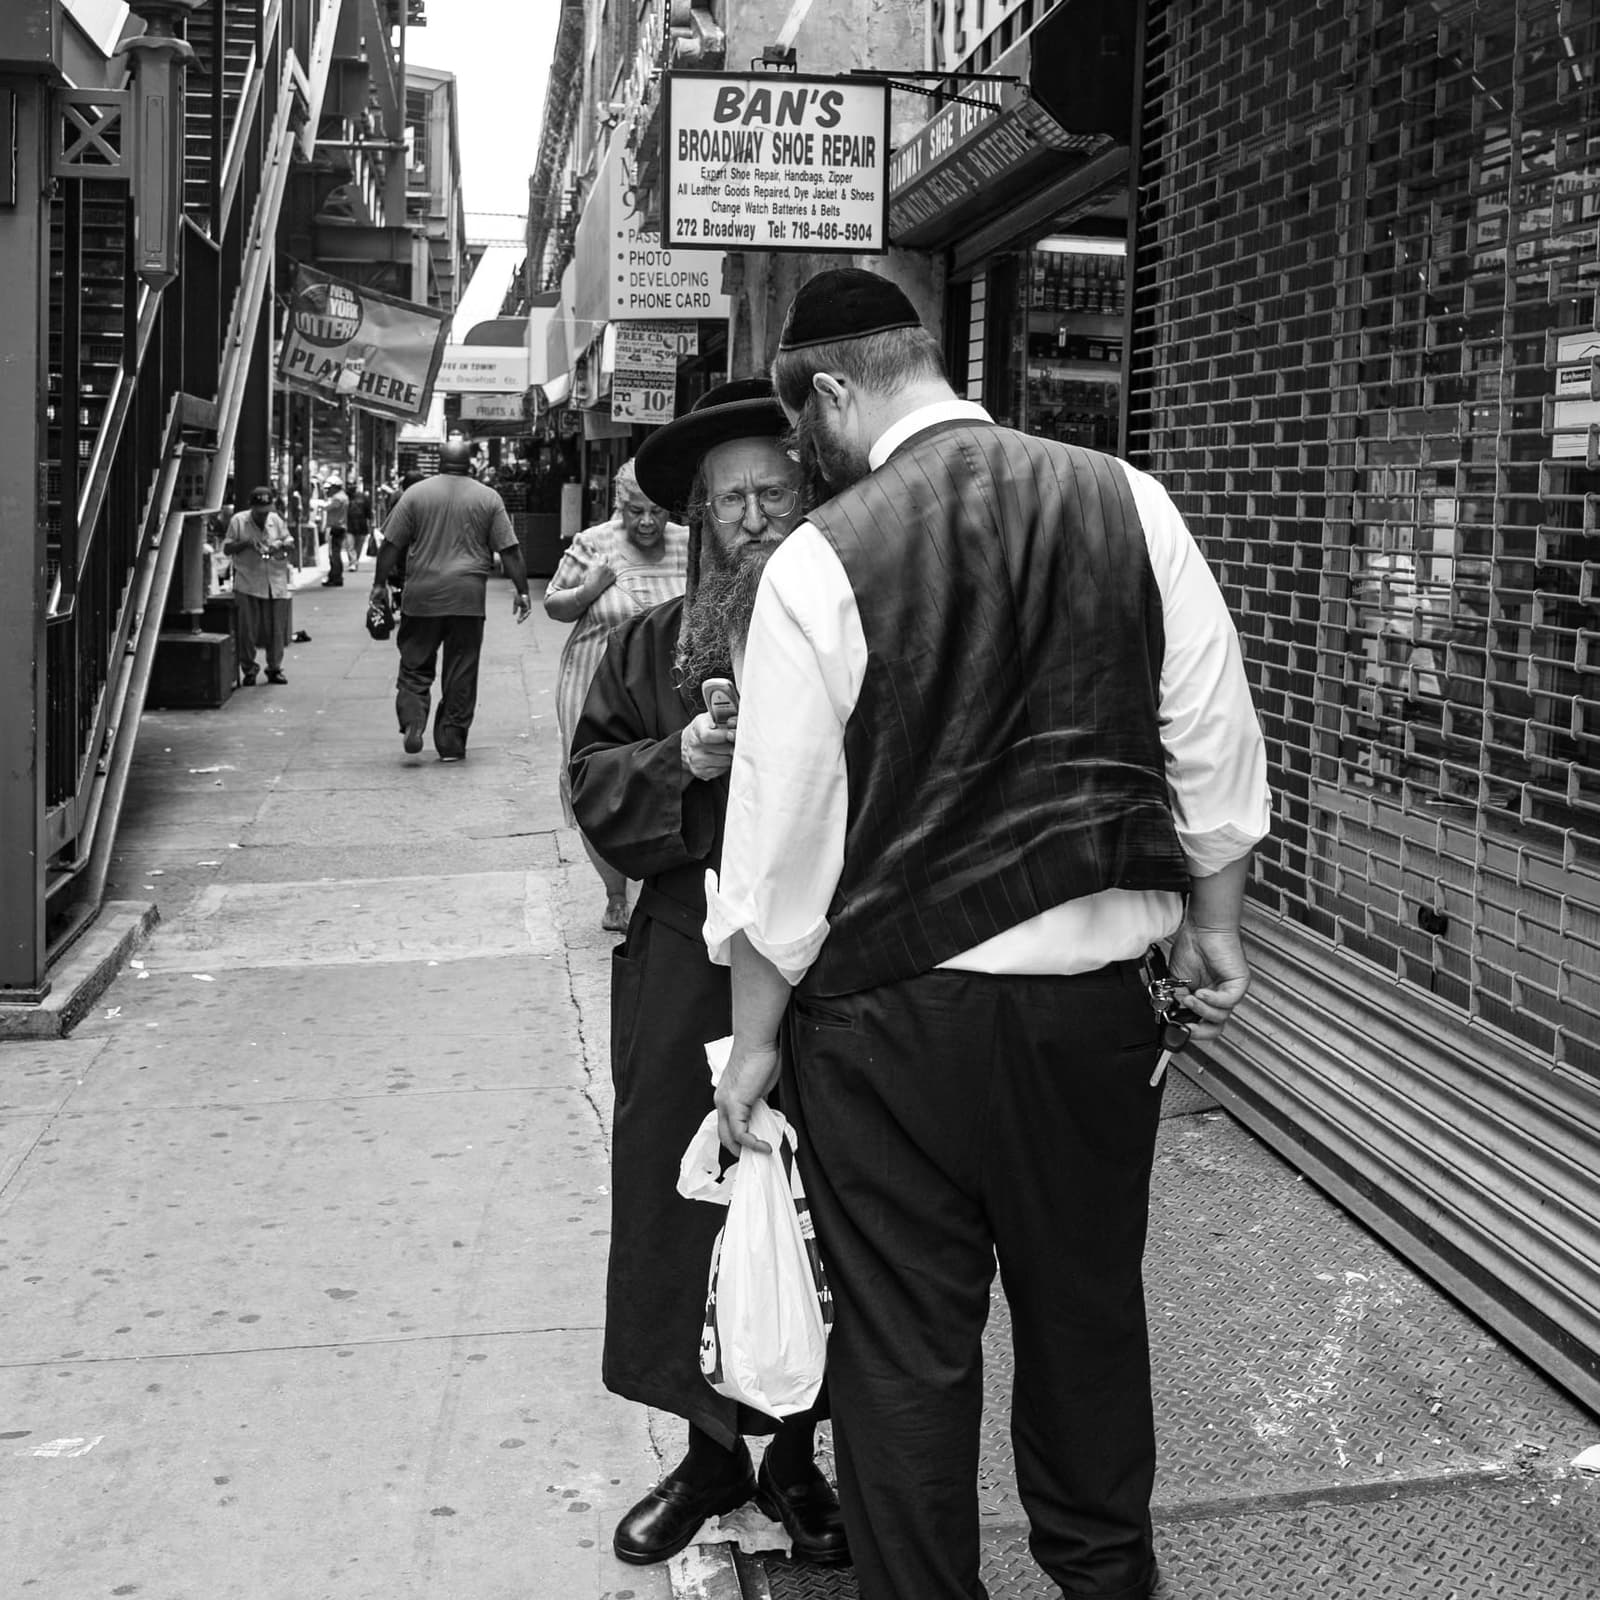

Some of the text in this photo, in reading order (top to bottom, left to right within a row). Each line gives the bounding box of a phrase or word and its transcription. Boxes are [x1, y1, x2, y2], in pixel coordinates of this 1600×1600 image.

[713, 86, 844, 128] BAN'S
[929, 111, 954, 161] SHOE
[678, 128, 876, 168] BROADWAY SHOE REPAIR
[701, 166, 853, 186] Expert Shoe Repair, Handbags, Zipper
[677, 182, 875, 202] All Leather Goods Repaired, Dye Jacket & Shoes
[712, 200, 841, 218] Change Watch Batteries & Belts
[676, 218, 873, 241] 272 Broadway Tel: 718-486-5904
[629, 250, 672, 266] PHOTO
[629, 271, 709, 287] DEVELOPING
[329, 298, 359, 319] YORK
[630, 292, 711, 308] PHONE CARD
[295, 311, 360, 340] LOTTERY
[357, 370, 420, 405] HERE
